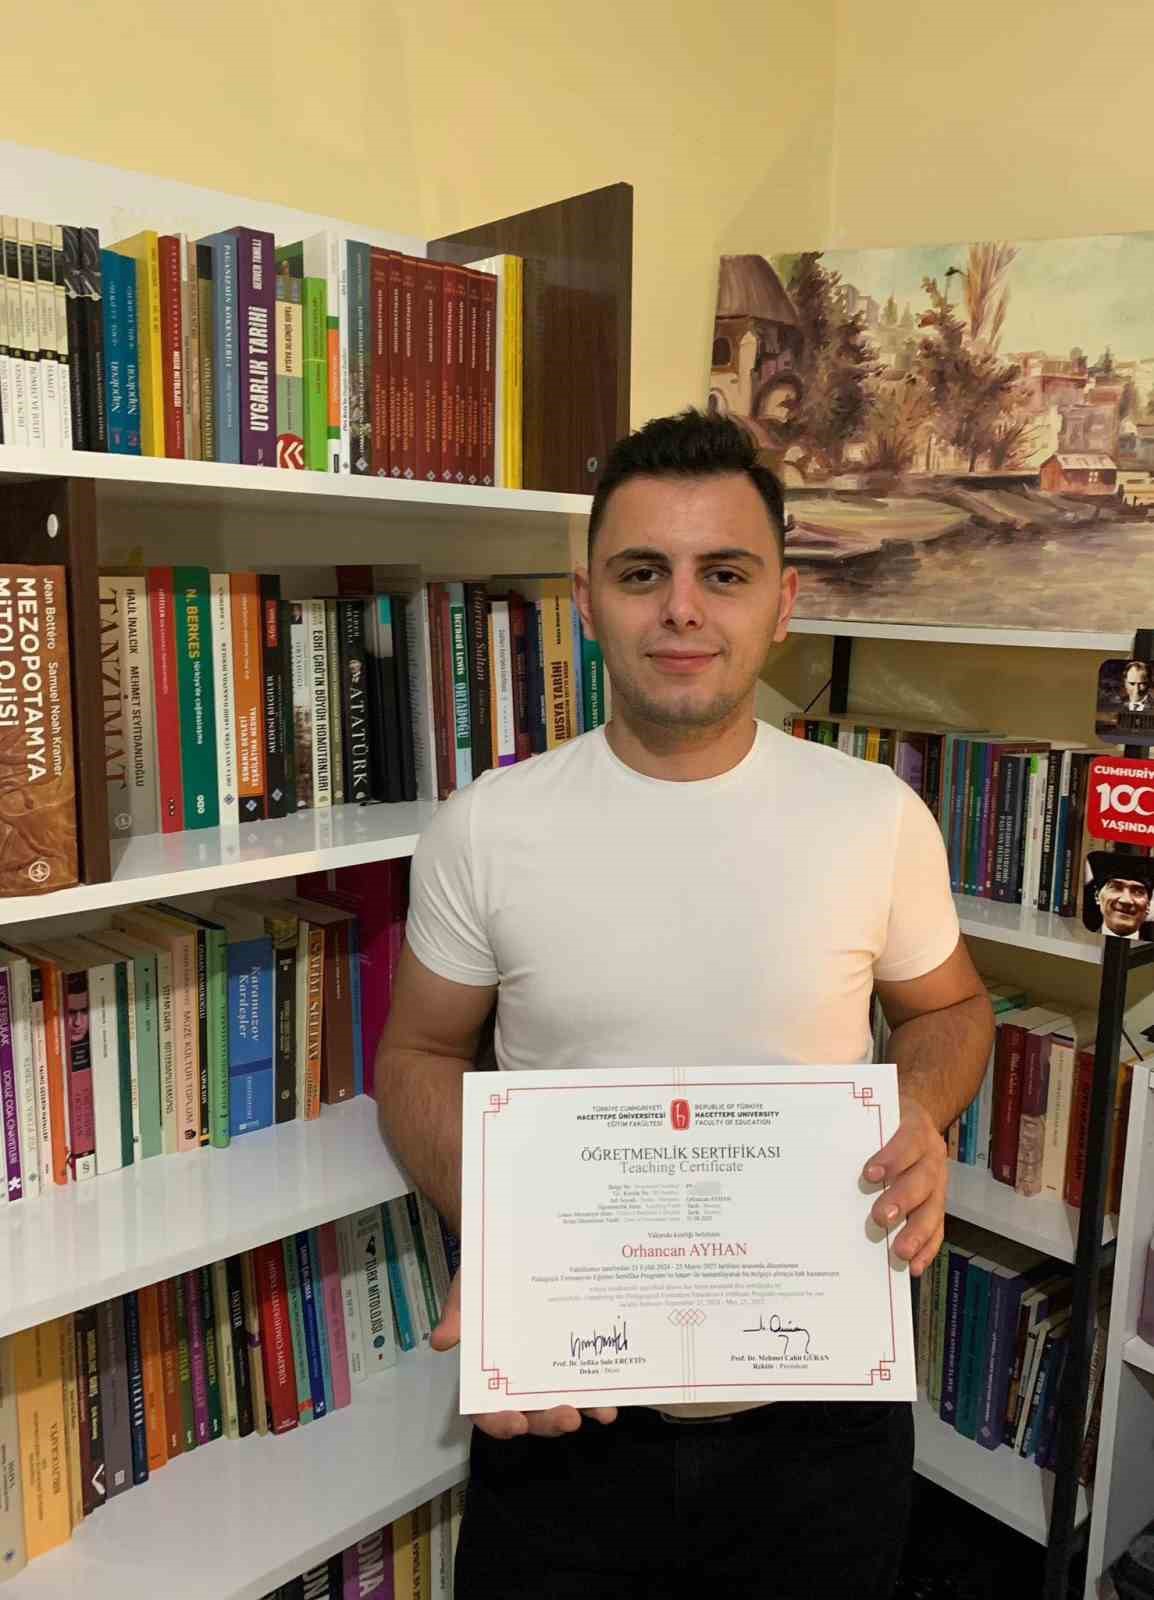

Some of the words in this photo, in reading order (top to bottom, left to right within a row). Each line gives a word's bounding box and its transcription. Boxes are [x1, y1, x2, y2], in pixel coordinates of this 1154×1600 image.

[248, 305, 269, 355] TARİHİ
[250, 361, 269, 432] UYGARLIK
[43, 577, 55, 604] Jean
[45, 606, 57, 650] Bottéro
[187, 605, 200, 659] BERKES
[16, 576, 47, 782] MEZOPOTAMYA
[48, 661, 60, 702] Samuel
[97, 588, 129, 791] TANZİMAT
[130, 665, 142, 707] MEHMET
[550, 660, 564, 700] TARİHİ
[51, 705, 62, 735] Noah
[350, 687, 368, 787] ATATÜRK
[553, 701, 567, 741] RUSYA
[53, 736, 64, 776] Kramer
[316, 724, 329, 792] KOMUTANLARI
[237, 974, 251, 1039] Kardeşler
[248, 966, 262, 1041] Karamazov
[618, 1111, 666, 1119] ÜNİVERSİTESİ
[735, 1118, 771, 1126] EDUCATION
[580, 1145, 689, 1162] ÖĞRETMENLİK
[691, 1144, 782, 1160] SERTİFİKASI
[620, 1160, 677, 1176] Teaching
[679, 1159, 744, 1173] Certificate
[621, 1243, 687, 1258] Orhancan
[689, 1241, 749, 1257] AYHAN
[366, 1258, 379, 1285] TÜRK
